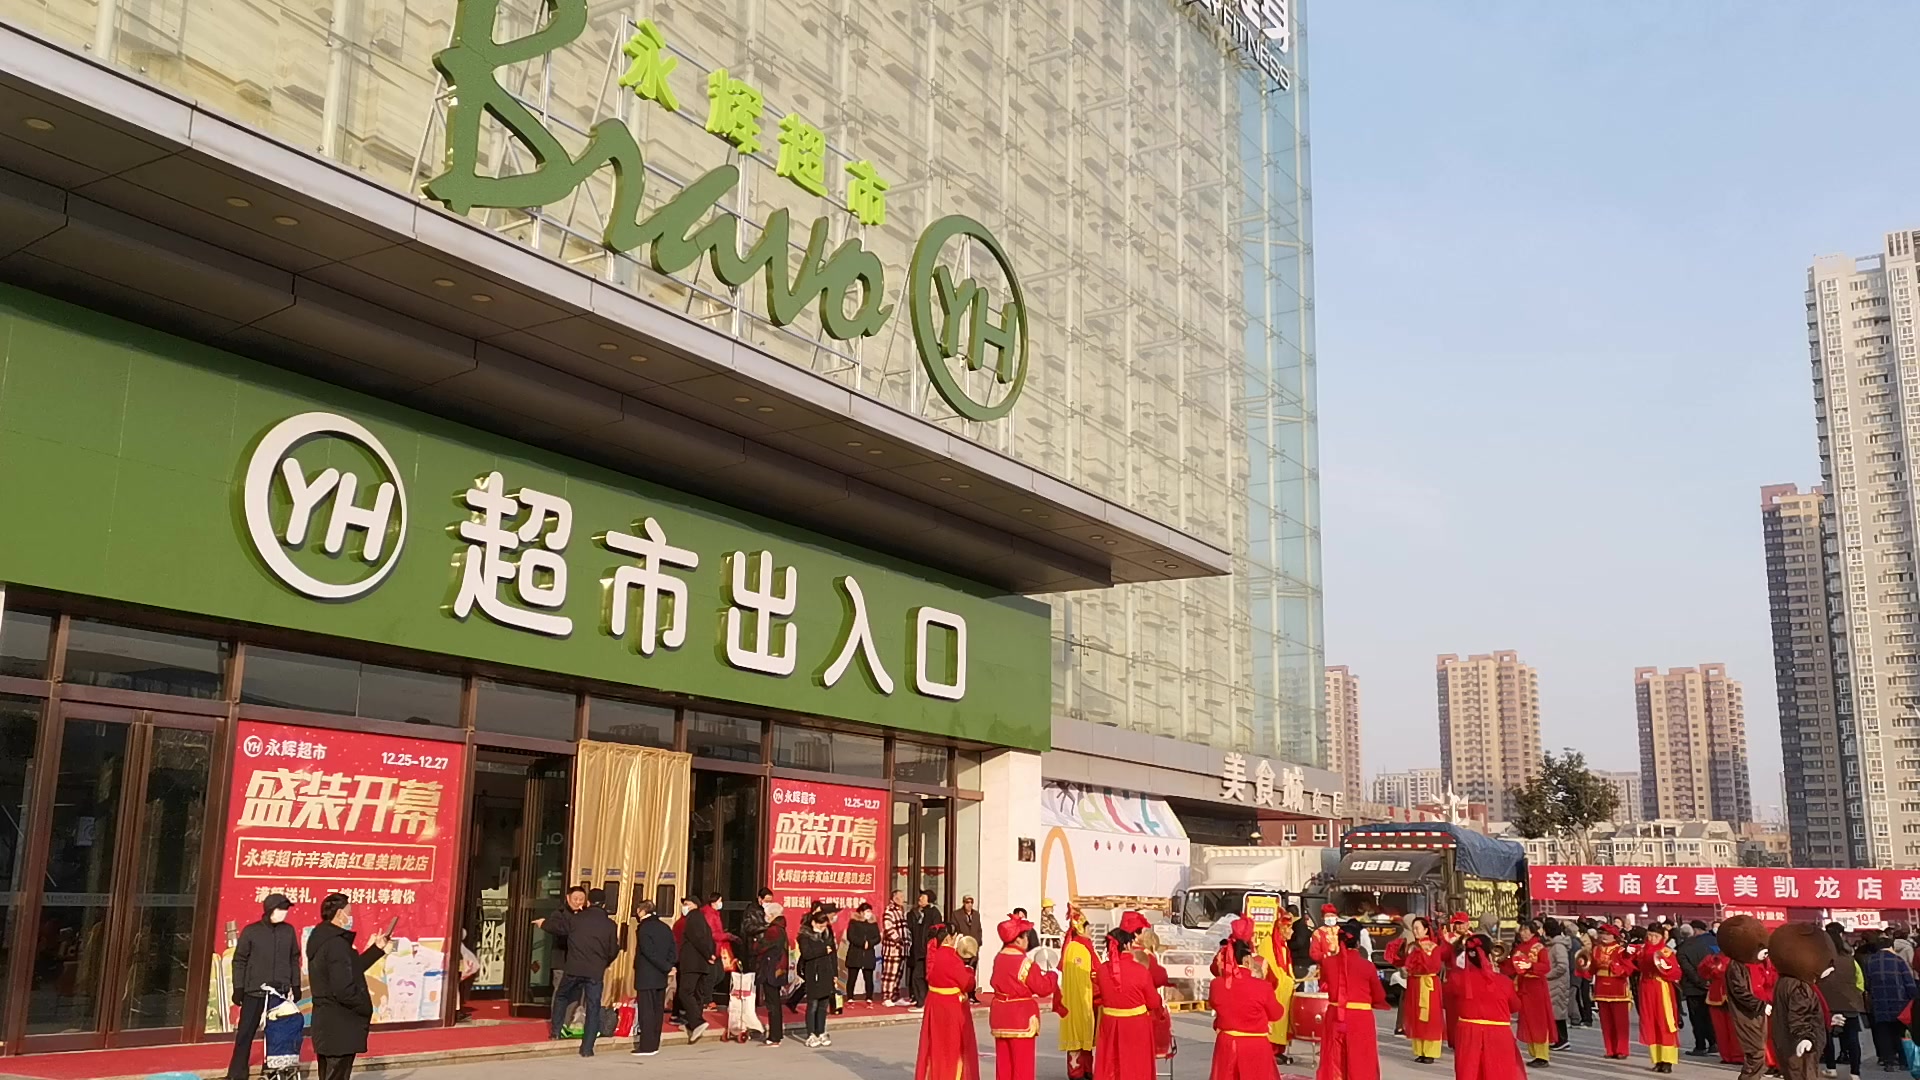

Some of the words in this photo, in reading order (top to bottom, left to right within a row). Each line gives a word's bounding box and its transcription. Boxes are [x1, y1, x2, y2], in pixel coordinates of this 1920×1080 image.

[1222, 4, 1290, 91] FITNESS
[617, 18, 889, 226] 永辉超市
[420, 0, 893, 340] Bravo
[452, 471, 968, 701] 超市出入口
[264, 739, 327, 760] 永辉超市
[381, 751, 449, 770] 12.25-12.27
[236, 767, 443, 836] 盛装开幕
[784, 791, 816, 805] 永辉超市
[242, 849, 429, 872] 永辉超市辛家庙红星美凯龙店
[772, 811, 878, 858] 盛装开幕
